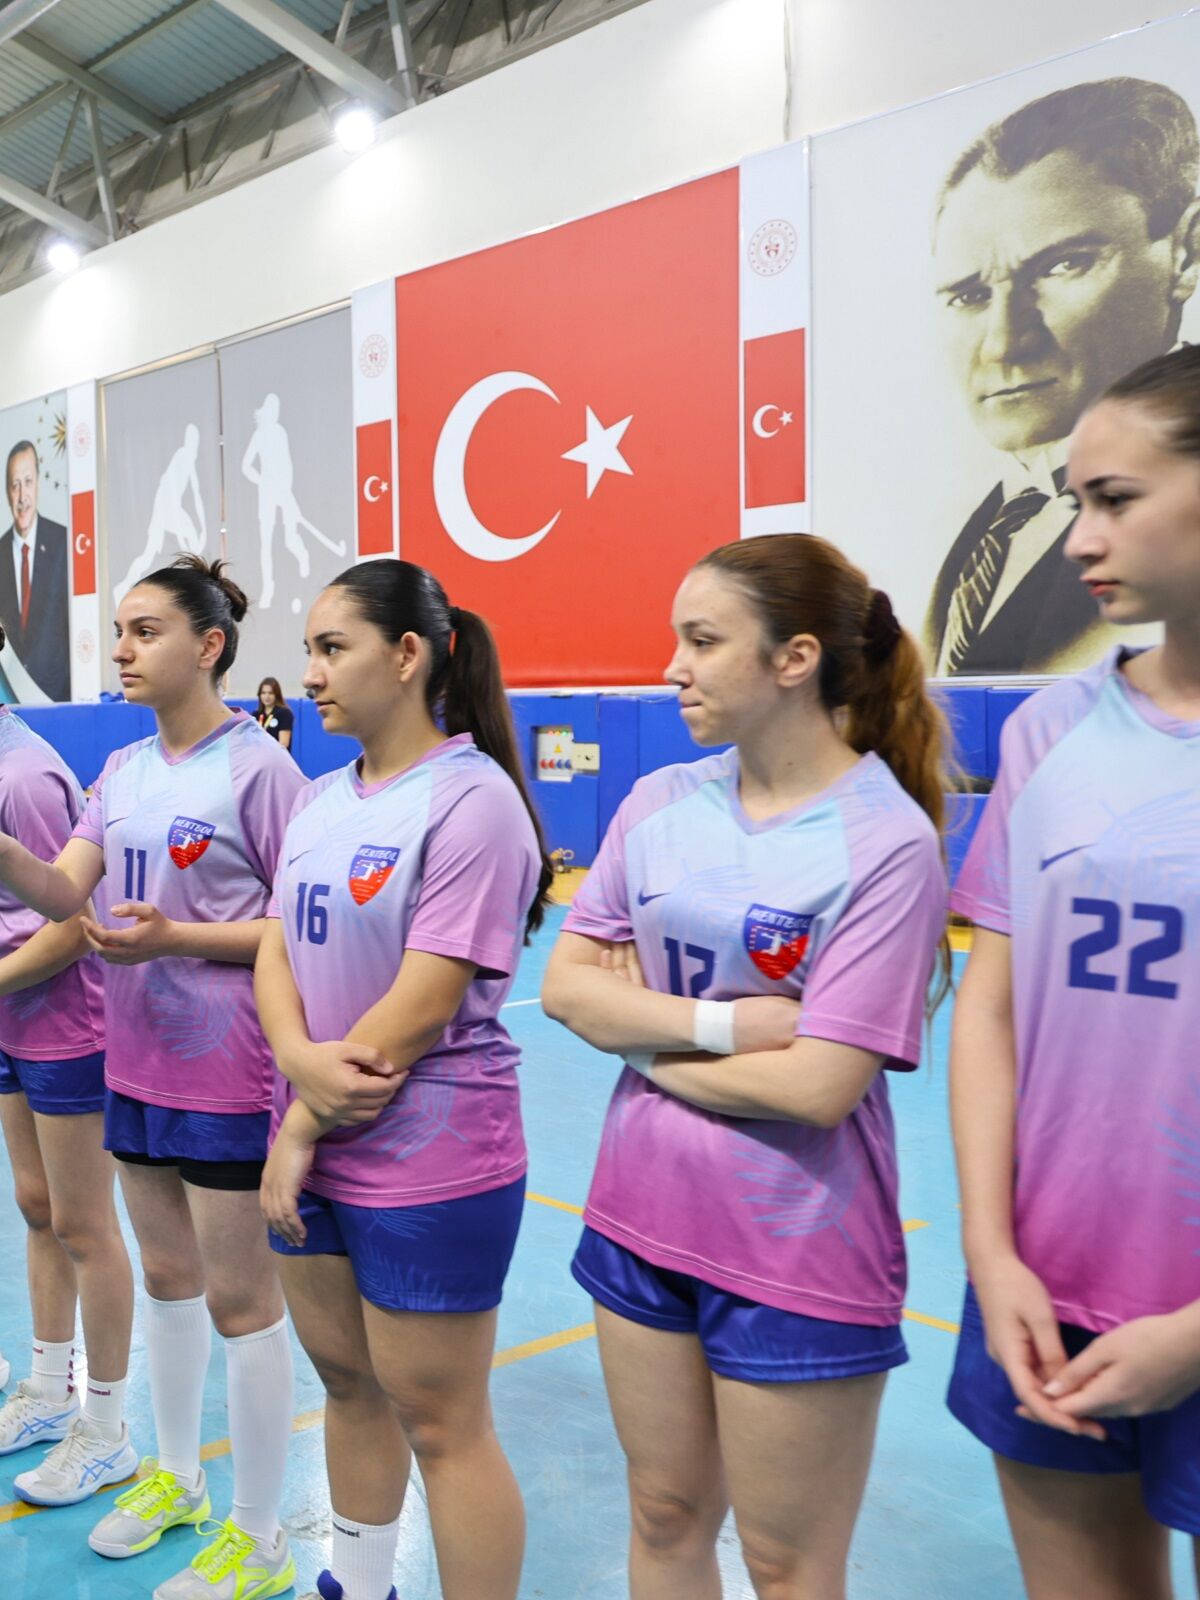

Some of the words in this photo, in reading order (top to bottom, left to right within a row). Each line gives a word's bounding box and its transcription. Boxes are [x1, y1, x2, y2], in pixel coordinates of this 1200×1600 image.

[124, 848, 147, 901] 11
[297, 882, 330, 945] 16
[1068, 897, 1182, 1000] 22
